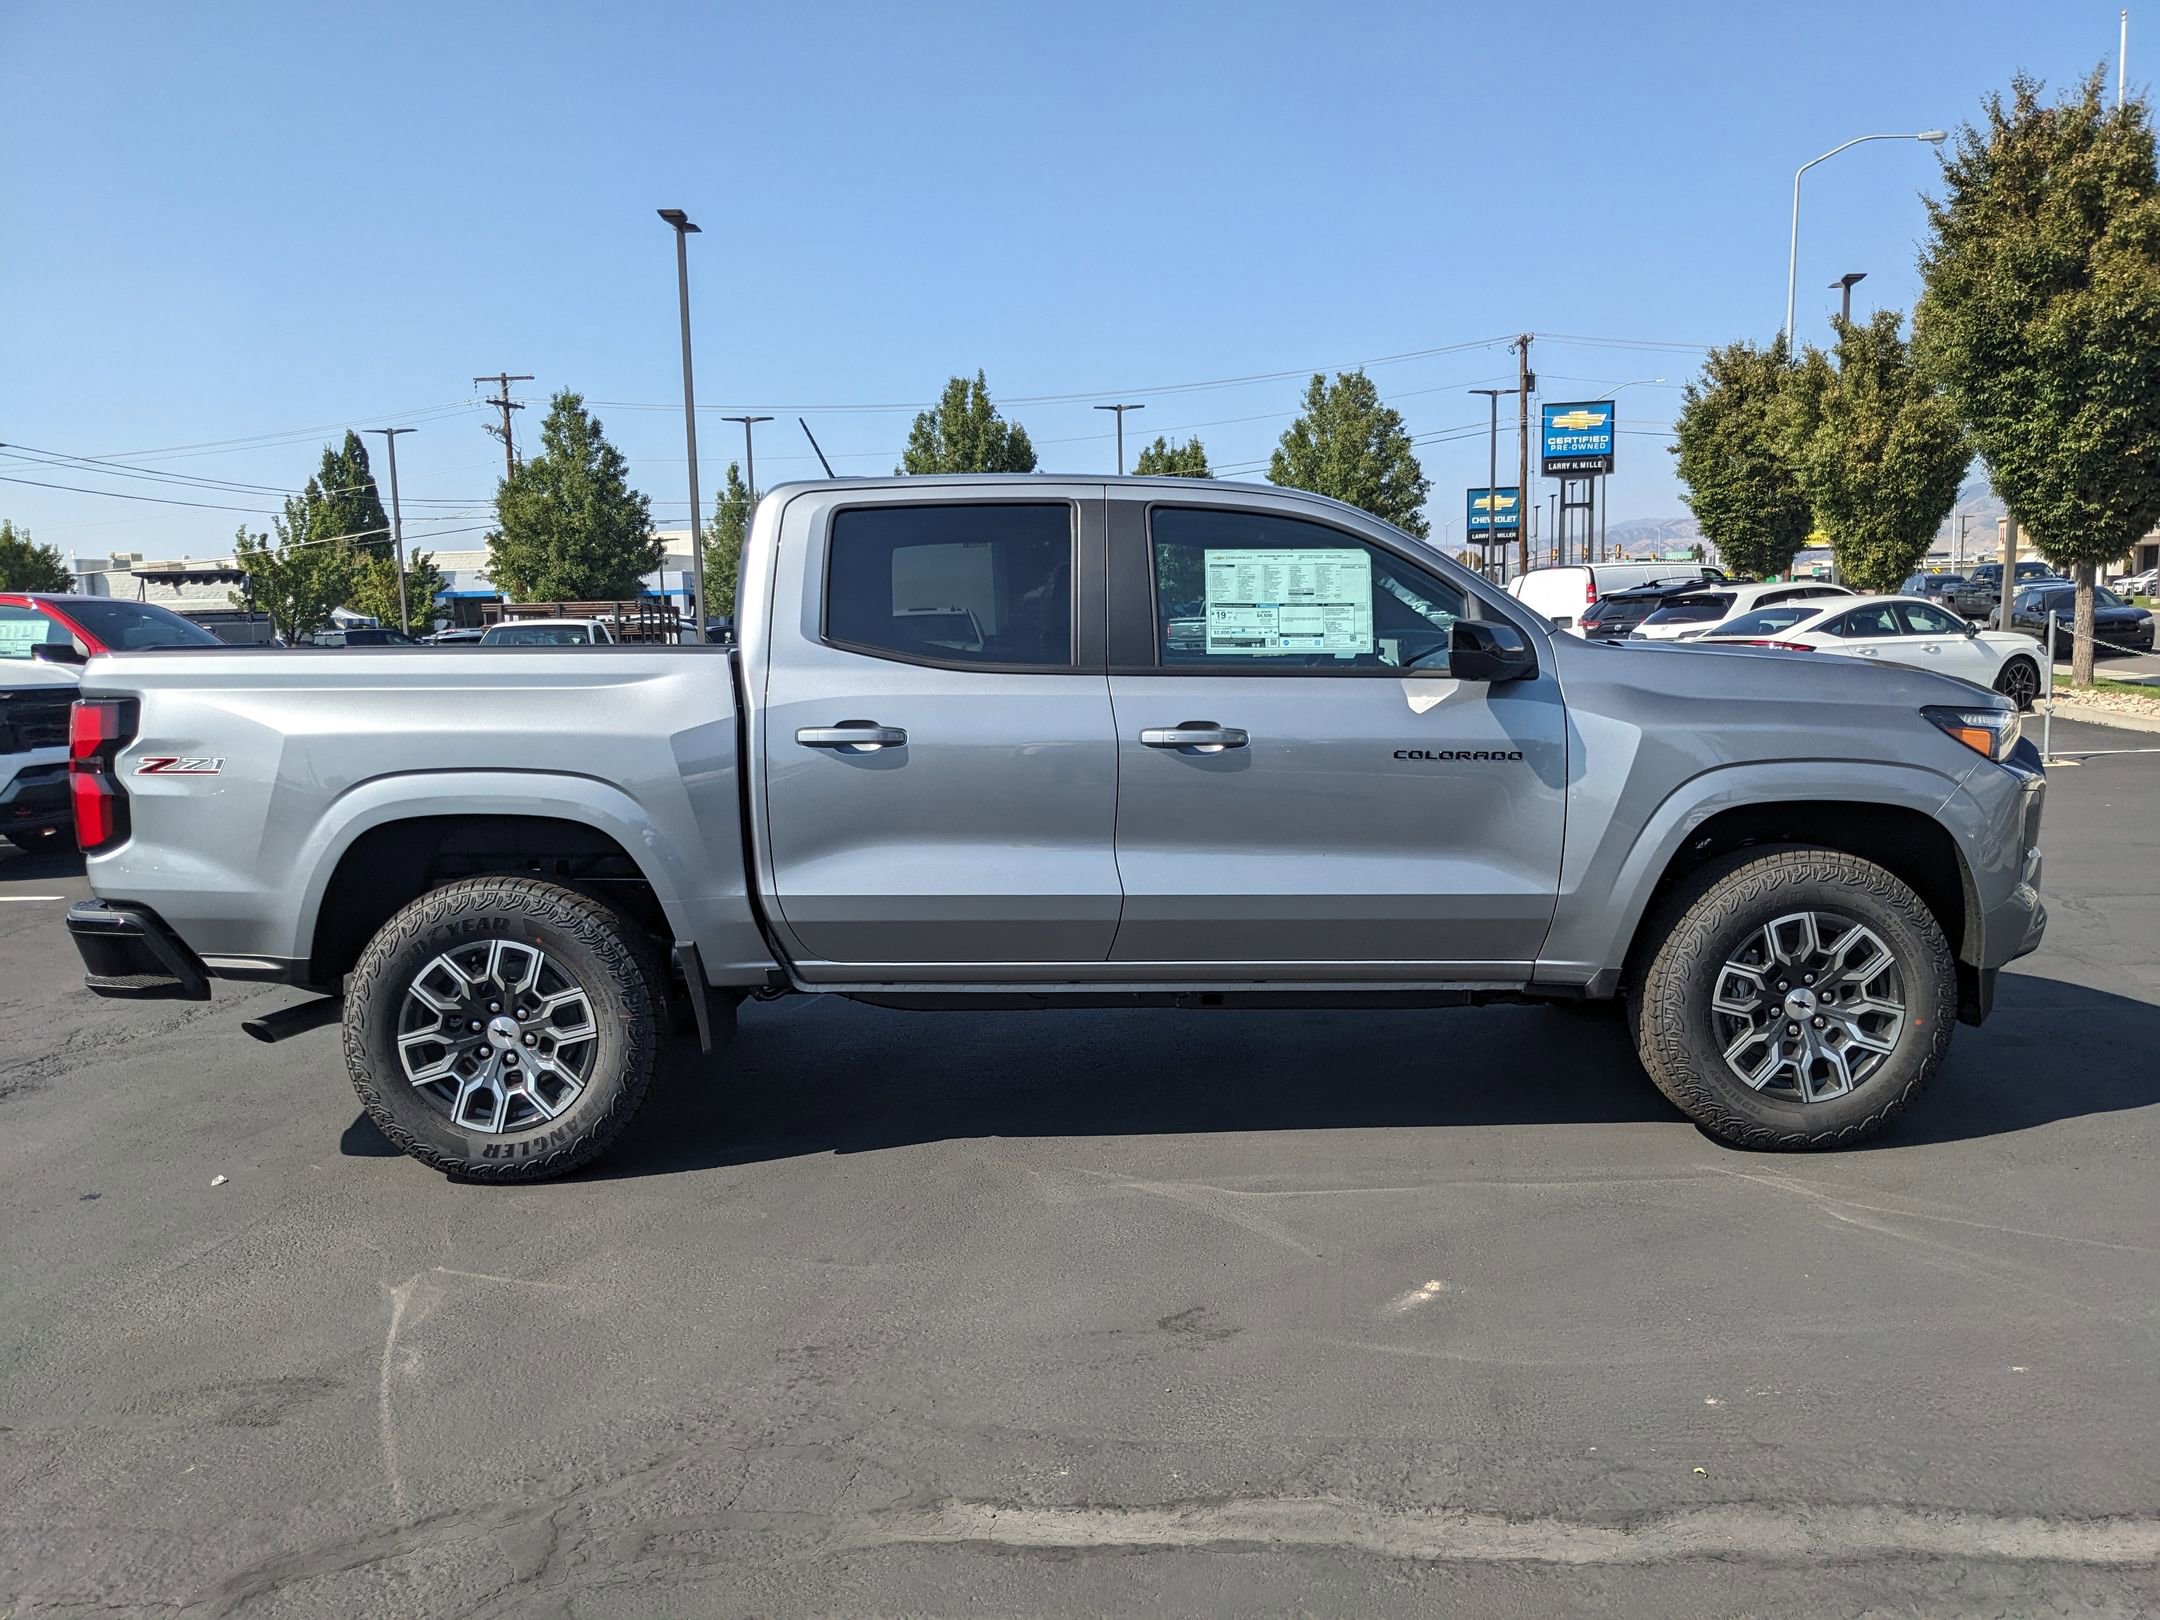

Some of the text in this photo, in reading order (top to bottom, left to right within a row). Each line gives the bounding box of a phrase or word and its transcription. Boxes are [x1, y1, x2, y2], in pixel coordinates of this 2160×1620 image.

[1548, 435, 1608, 444] CERTIFIED
[1550, 443, 1606, 452] PRE-OWNED
[1548, 462, 1570, 471] LARRY
[1216, 611, 1226, 619] 19
[1393, 750, 1523, 761] COLORADO
[132, 756, 226, 775] Z71
